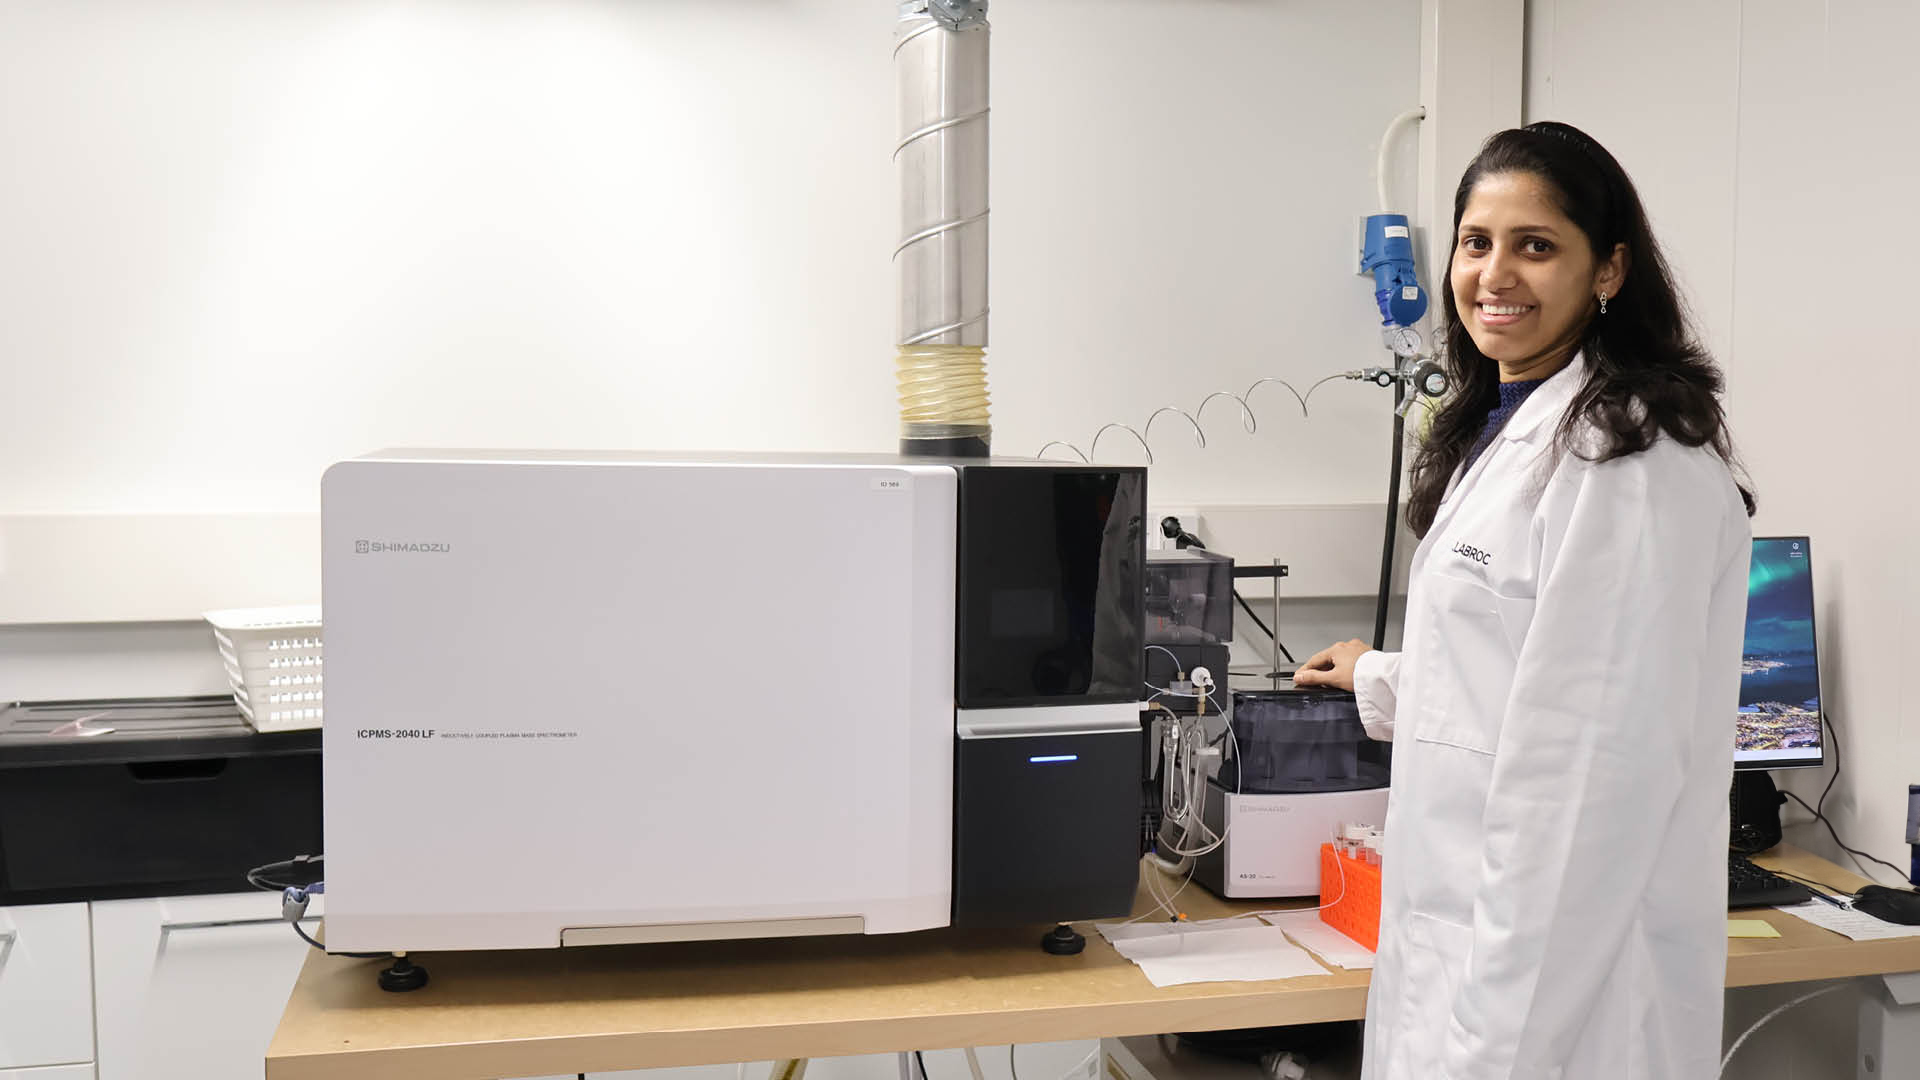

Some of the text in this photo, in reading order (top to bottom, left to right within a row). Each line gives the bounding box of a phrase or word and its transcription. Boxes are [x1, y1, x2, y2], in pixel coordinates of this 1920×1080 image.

[371, 542, 450, 553] SHIMADZU
[357, 729, 420, 739] ICPMS-2040
[421, 729, 436, 739] LF
